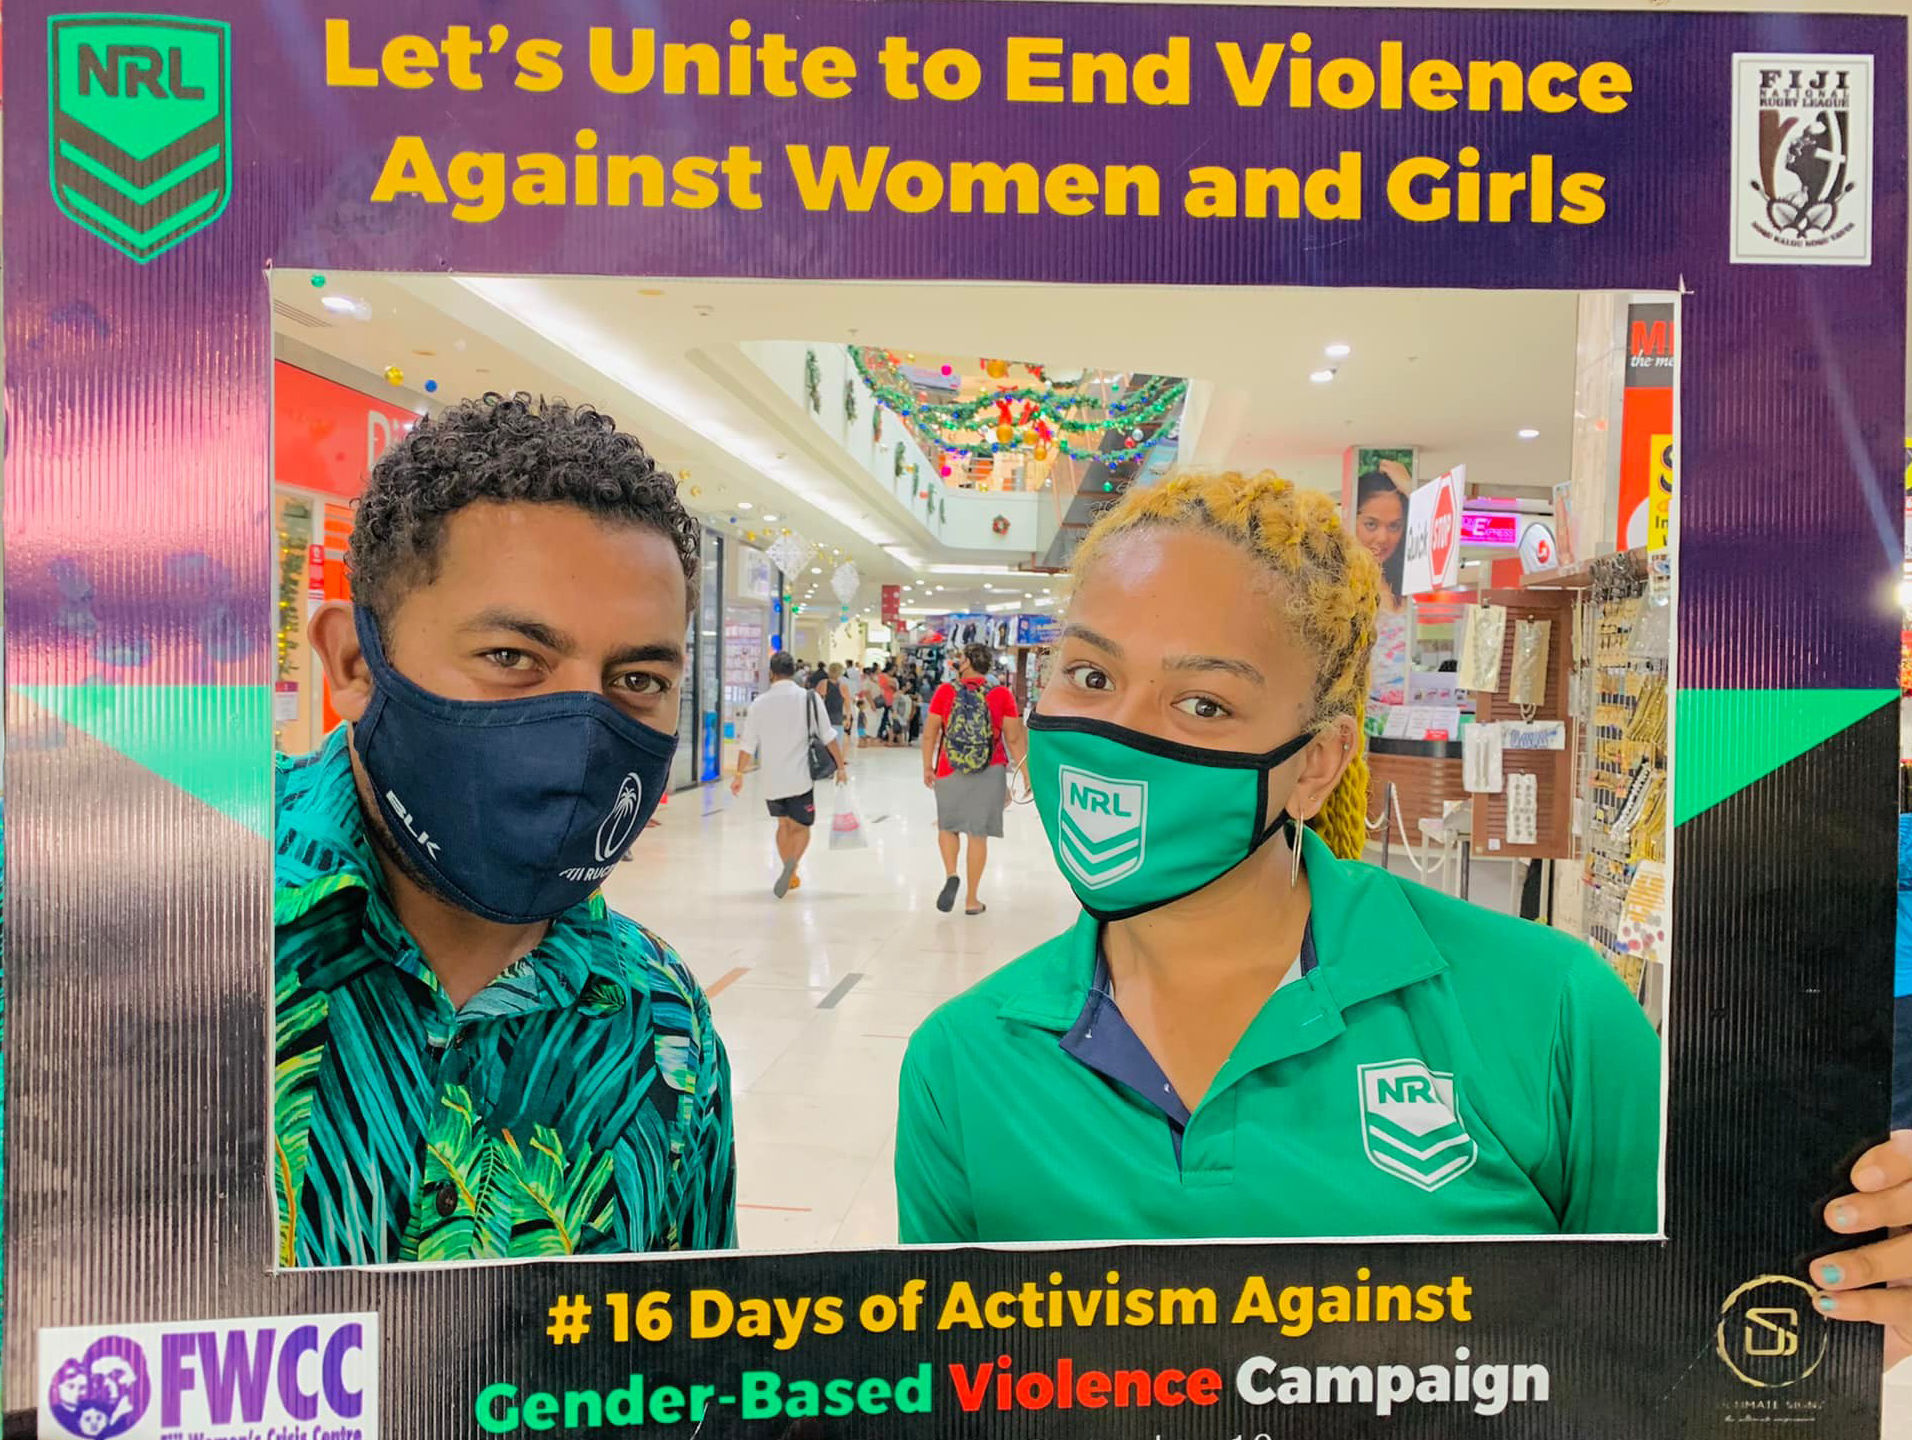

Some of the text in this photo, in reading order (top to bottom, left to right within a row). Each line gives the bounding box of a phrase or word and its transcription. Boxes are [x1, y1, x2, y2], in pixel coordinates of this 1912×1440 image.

[78, 43, 205, 100] NRL
[590, 19, 857, 100] Unite
[878, 37, 982, 102] to
[1007, 37, 1191, 106] End
[1216, 32, 1633, 114] Violence
[1760, 69, 1849, 89] FIJI
[1760, 98, 1849, 108] RUGBY LEAGUE
[372, 129, 1606, 225] Against Women and Girls
[1431, 514, 1453, 551] STOP
[386, 789, 441, 861] BLK
[1070, 782, 1132, 818] NRL
[1377, 1076, 1436, 1104] NR
[606, 1290, 673, 1343] 16
[690, 1289, 844, 1351] Days
[860, 1278, 927, 1333] of
[937, 1271, 1217, 1330] Activism
[1232, 1266, 1473, 1338] Against
[161, 1322, 363, 1428] FWCC
[474, 1346, 1550, 1434] Gender-Based Violence Campaign
